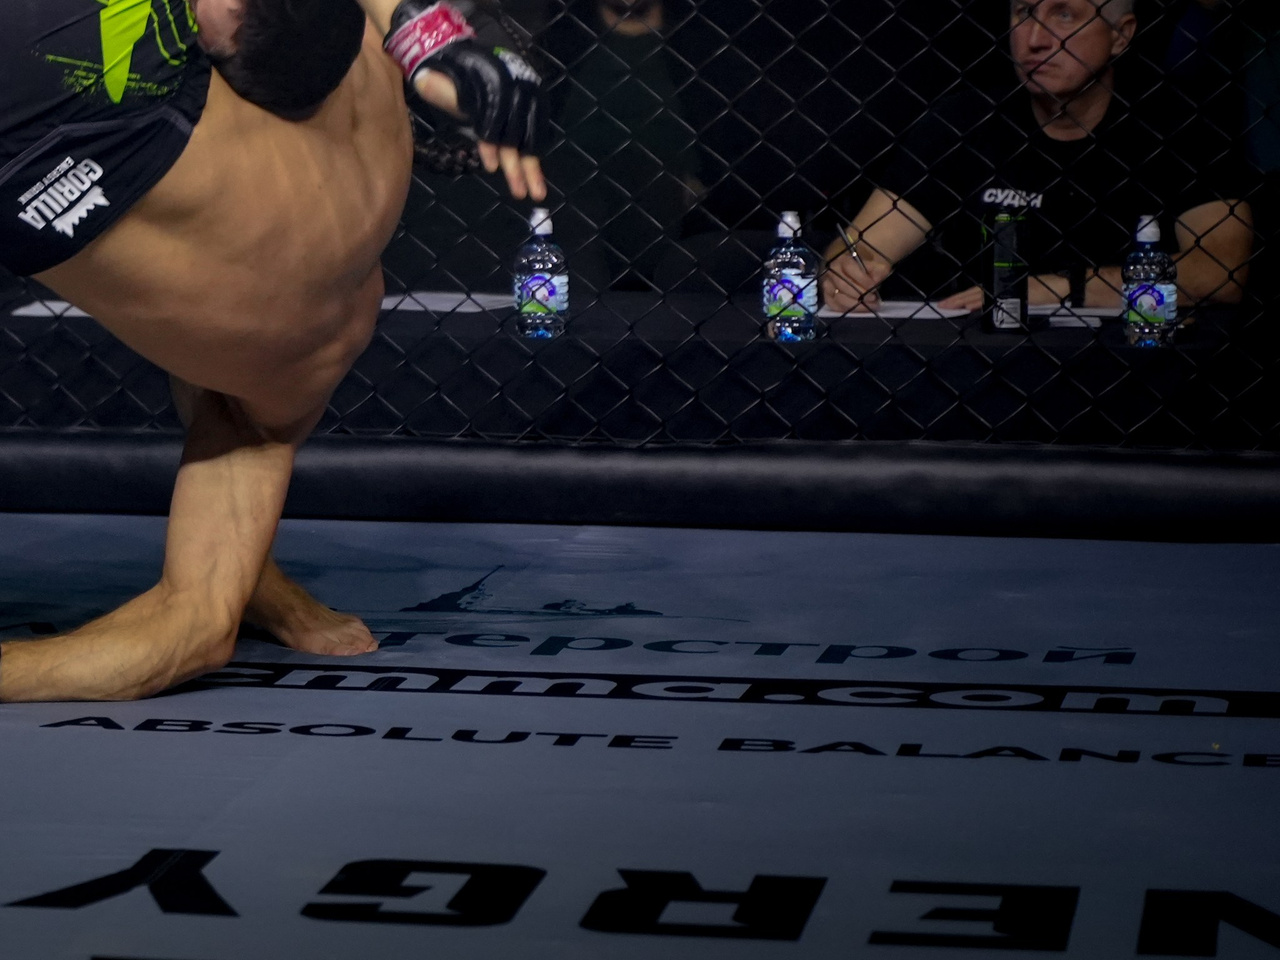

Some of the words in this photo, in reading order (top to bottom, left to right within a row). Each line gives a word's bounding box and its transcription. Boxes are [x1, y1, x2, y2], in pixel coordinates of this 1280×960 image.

[18, 158, 104, 230] GORILLA
[360, 631, 1137, 666] терстрой
[39, 716, 679, 750] ABSOLUTE
[3, 849, 1280, 957] NERGY
